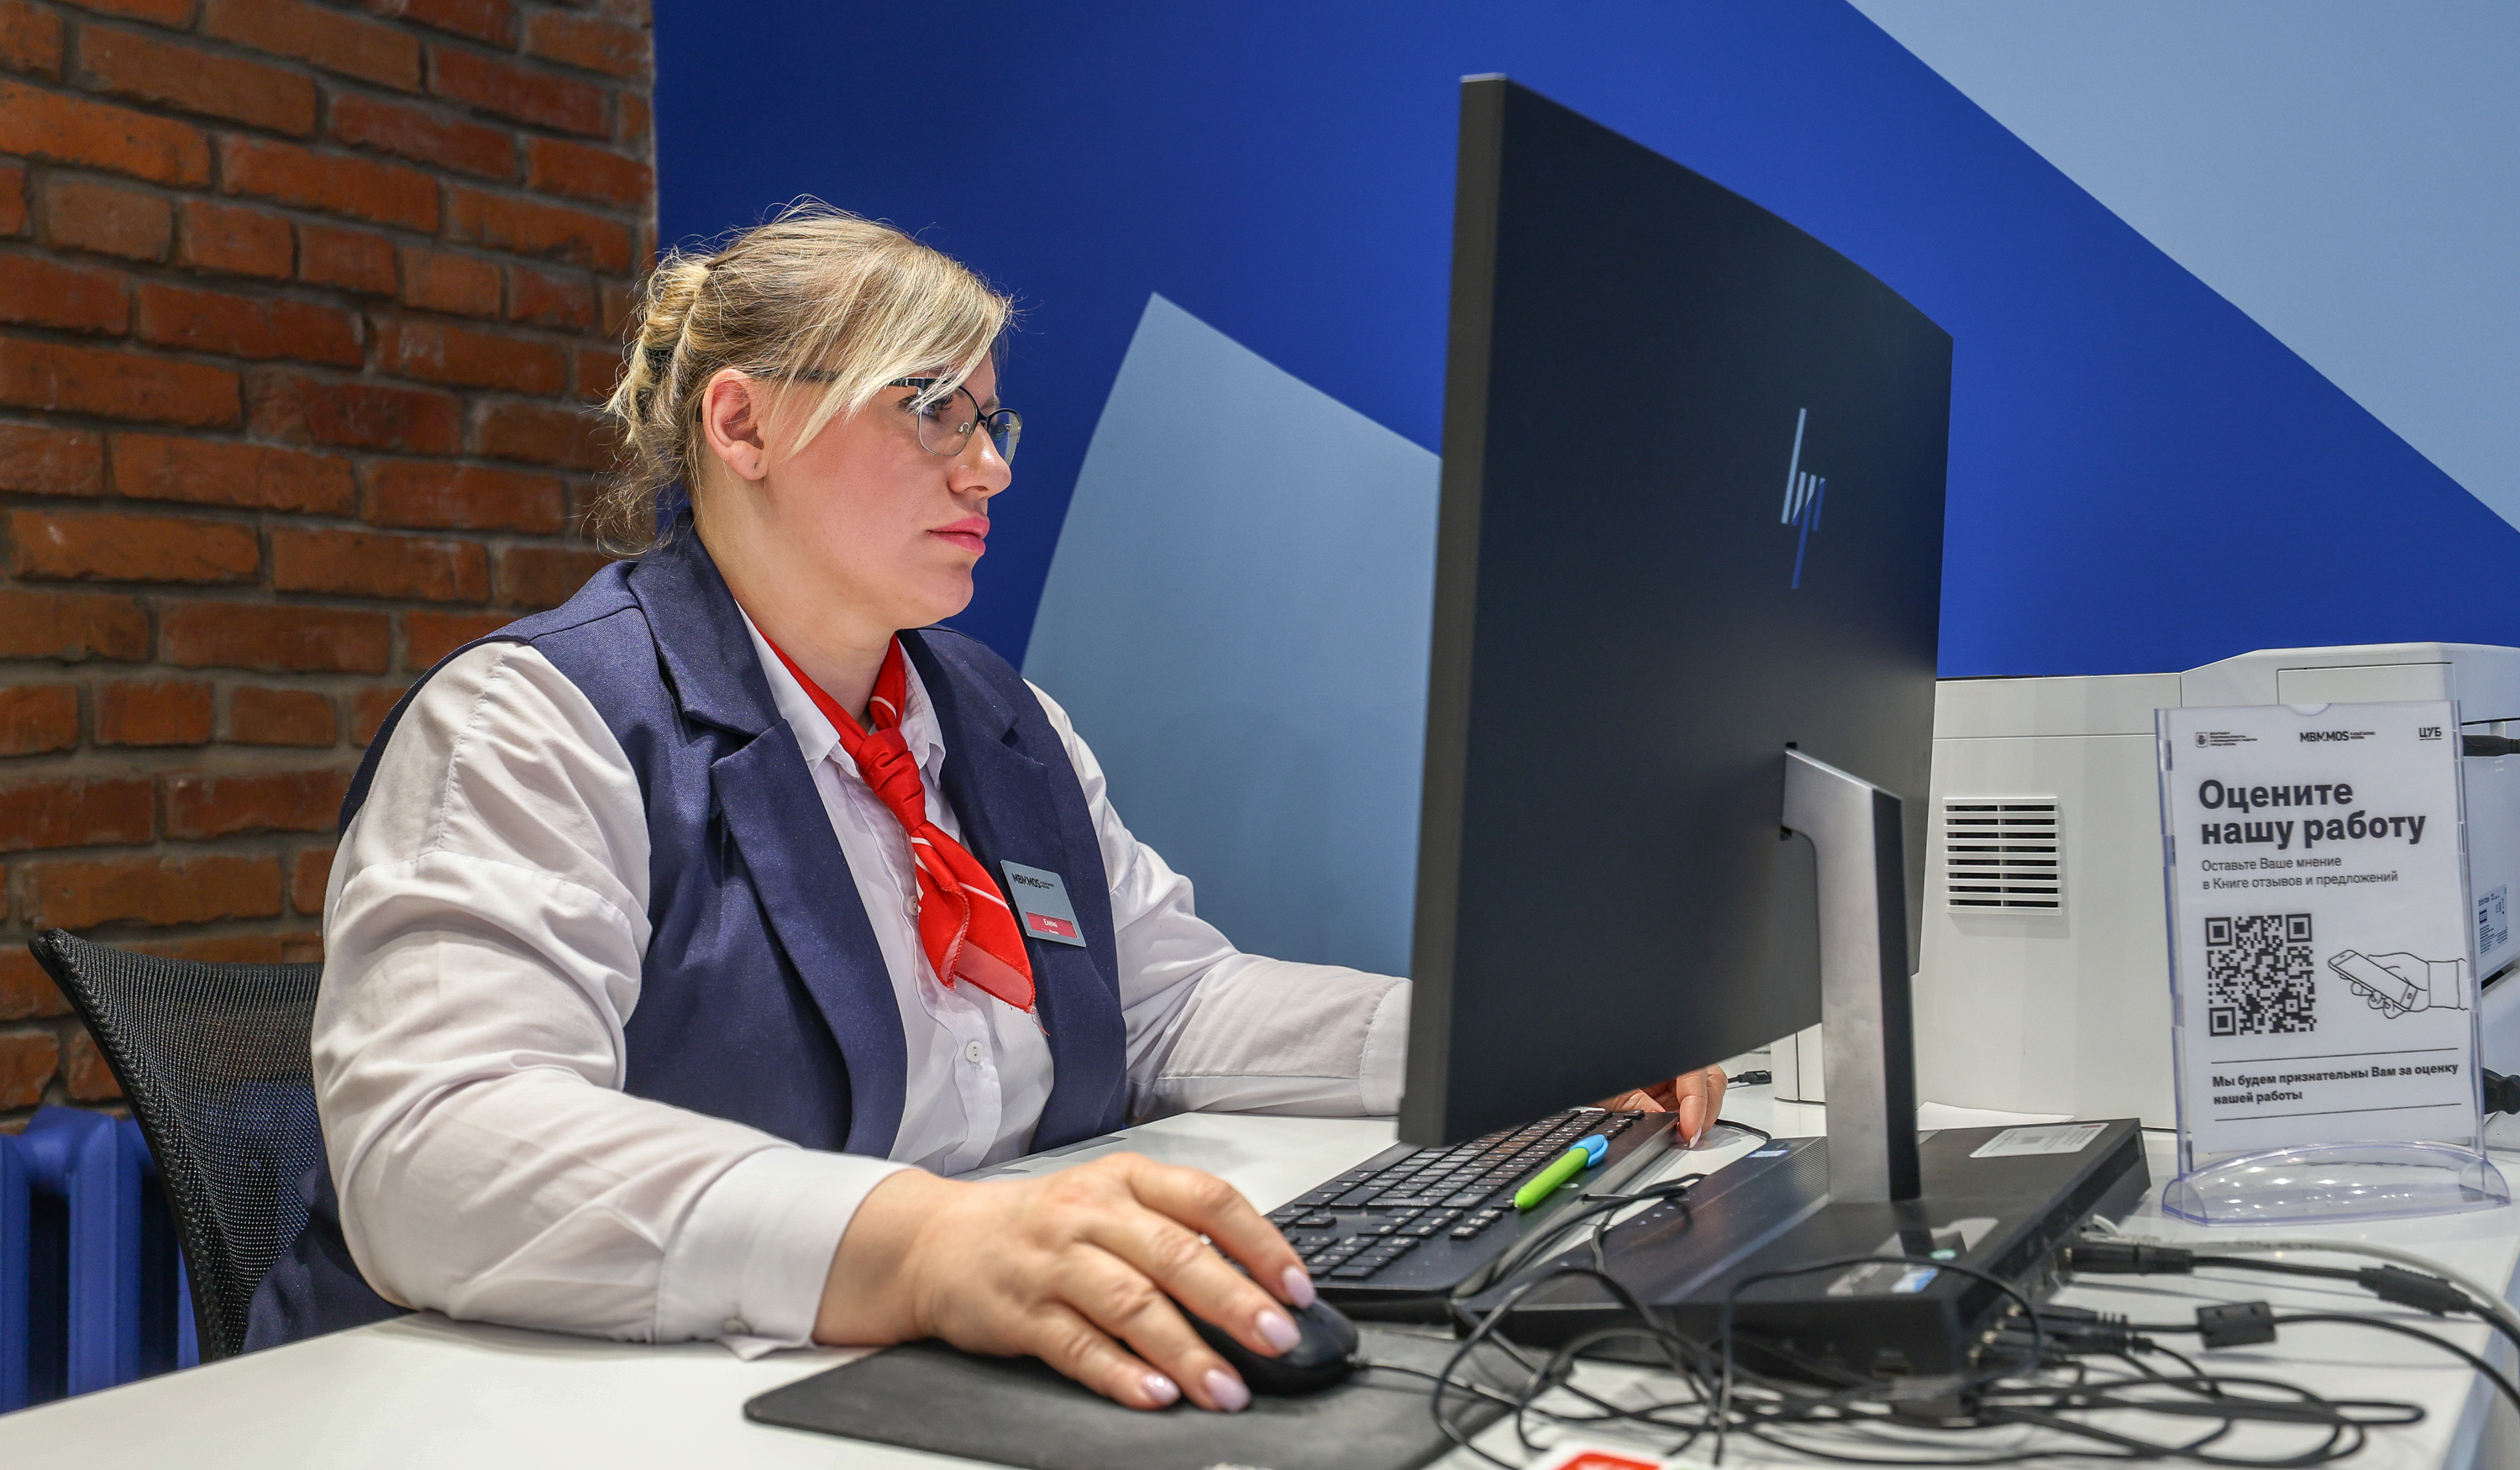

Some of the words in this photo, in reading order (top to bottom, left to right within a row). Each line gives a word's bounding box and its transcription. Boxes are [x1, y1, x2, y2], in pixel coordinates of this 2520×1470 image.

[2419, 727, 2441, 738] ЦУБ
[2199, 780, 2353, 813] Оцените
[2202, 821, 2294, 850] нашу
[2304, 811, 2426, 848] работу
[2202, 860, 2256, 871] Оставьте
[2260, 858, 2292, 869] Ваше
[2297, 858, 2341, 867] мнение
[2203, 881, 2209, 890] в
[2213, 878, 2249, 889] Книге
[2253, 878, 2302, 887] отзывов
[2317, 871, 2397, 887] предложений
[2213, 1076, 2234, 1087] Мы
[2238, 1075, 2276, 1088] будем
[2280, 1070, 2368, 1084] признательны
[2372, 1067, 2396, 1077] Вам
[2415, 1064, 2458, 1077] оценку
[2214, 1092, 2253, 1105] нашей
[2256, 1090, 2302, 1105] работы
